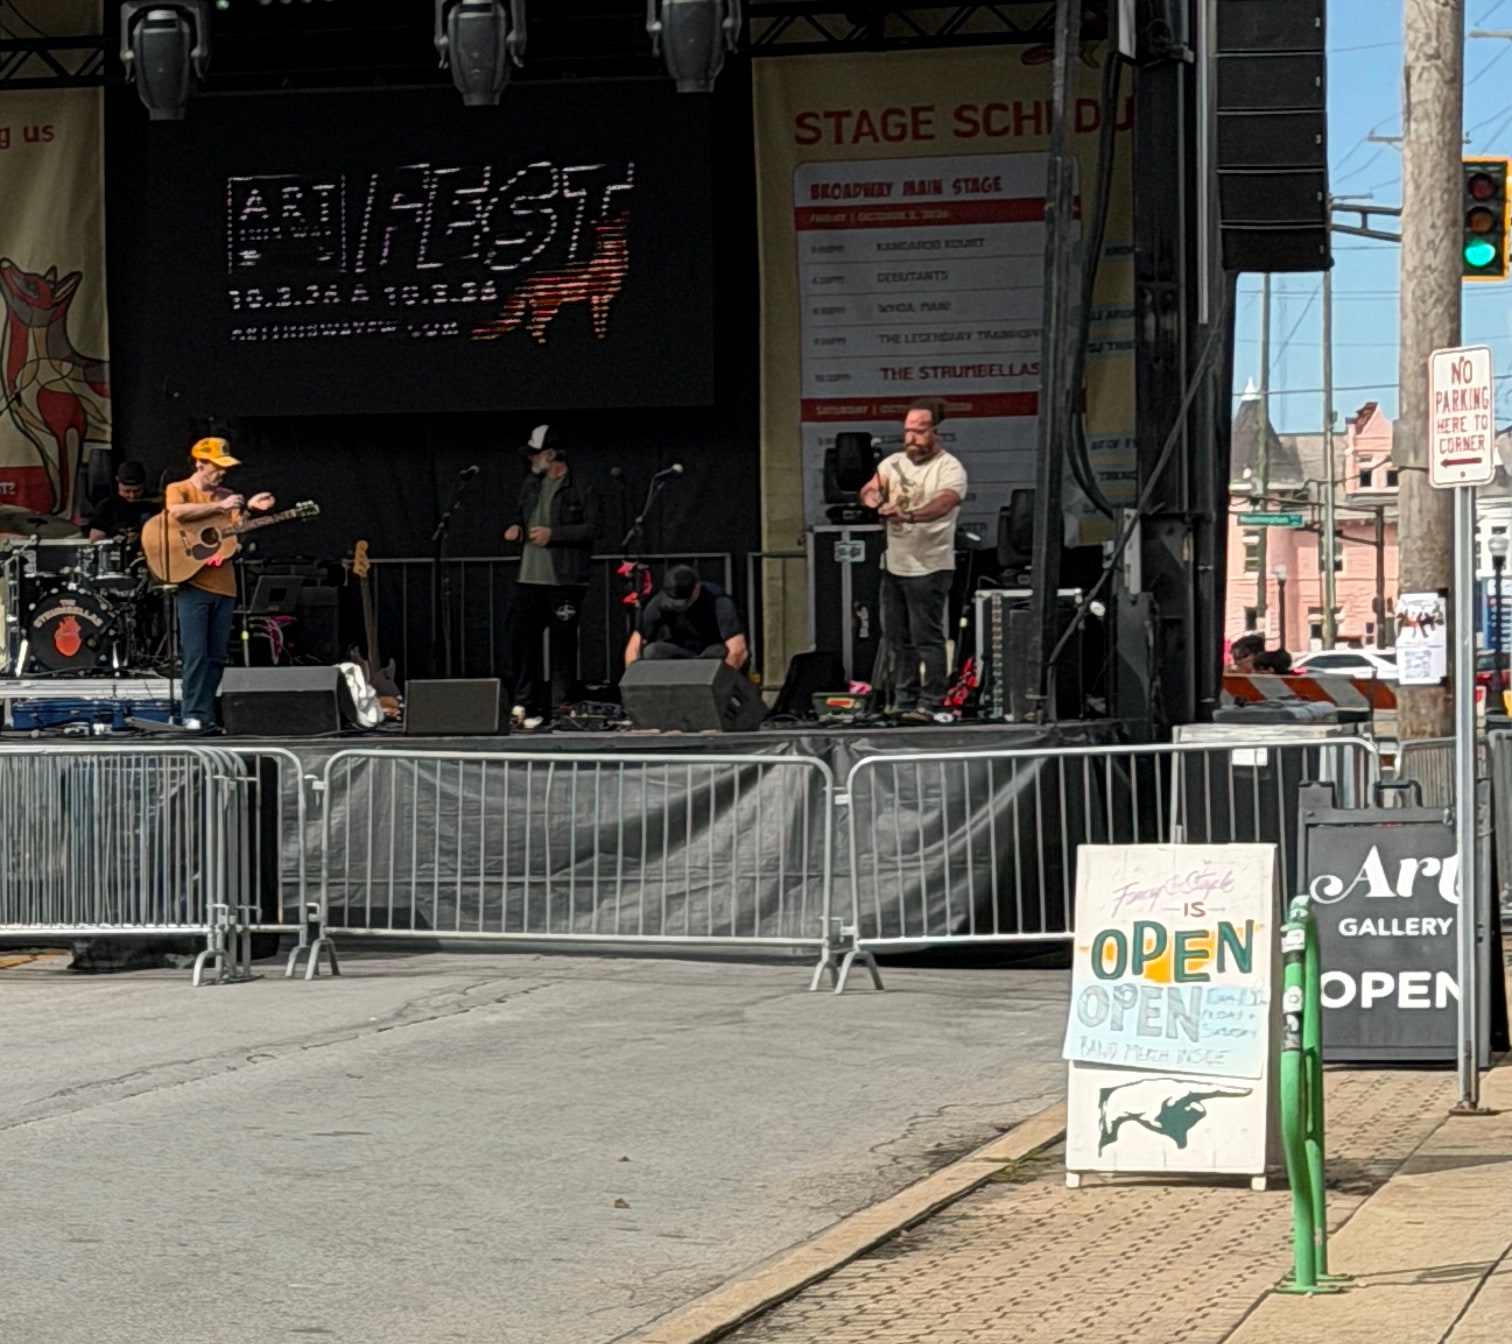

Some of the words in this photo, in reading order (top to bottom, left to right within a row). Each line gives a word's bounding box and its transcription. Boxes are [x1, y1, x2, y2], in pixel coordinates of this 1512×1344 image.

[23, 124, 55, 144] us
[794, 105, 936, 145] STAGE
[809, 181, 893, 200] BROADWAY
[902, 179, 943, 197] MAIN
[952, 176, 1003, 195] STAGE
[238, 184, 336, 222] ART
[354, 160, 636, 274] FEST
[879, 366, 916, 381] THE
[918, 361, 1041, 380] STRUMBELLAS
[1451, 359, 1473, 385] NO
[1435, 386, 1489, 413] PARKING
[1436, 416, 1467, 434] HERE
[1474, 414, 1488, 431] TO
[1439, 434, 1486, 454] CORNER
[1309, 844, 1462, 905] Art
[1183, 901, 1207, 918] IS
[1338, 916, 1454, 937] GALLERY
[1090, 918, 1255, 984] OPEN
[1320, 970, 1461, 1009] OPEN
[1076, 982, 1203, 1043] OPEN
